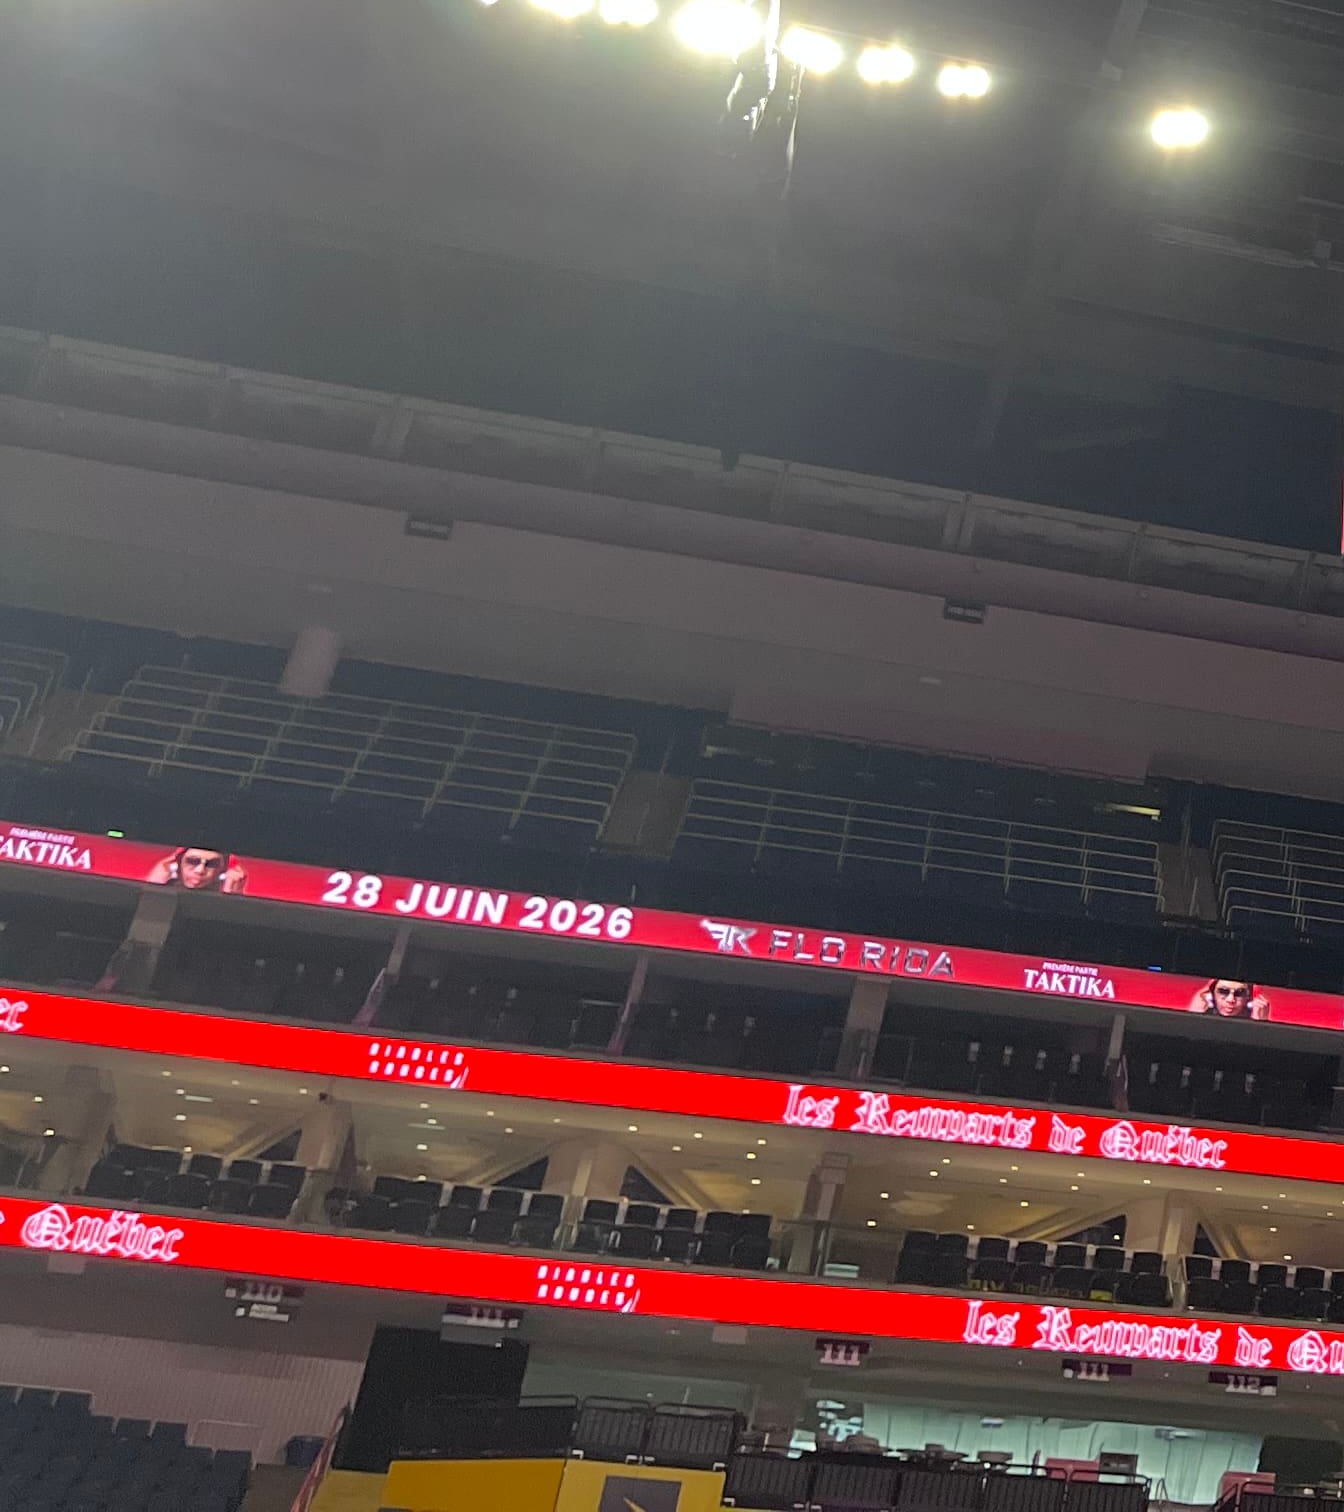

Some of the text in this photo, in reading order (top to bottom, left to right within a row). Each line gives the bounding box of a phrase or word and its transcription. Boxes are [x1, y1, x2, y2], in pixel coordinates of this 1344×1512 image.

[322, 870, 635, 941] 28 JUIN 2026
[768, 929, 847, 965] FLO
[1023, 968, 1115, 999] TAKTIKA
[782, 1084, 1228, 1169] les Remparts de Québec
[19, 1203, 184, 1263] Québec
[962, 1300, 1020, 1347] les
[1032, 1305, 1222, 1365] Remparts
[1233, 1326, 1274, 1369] de
